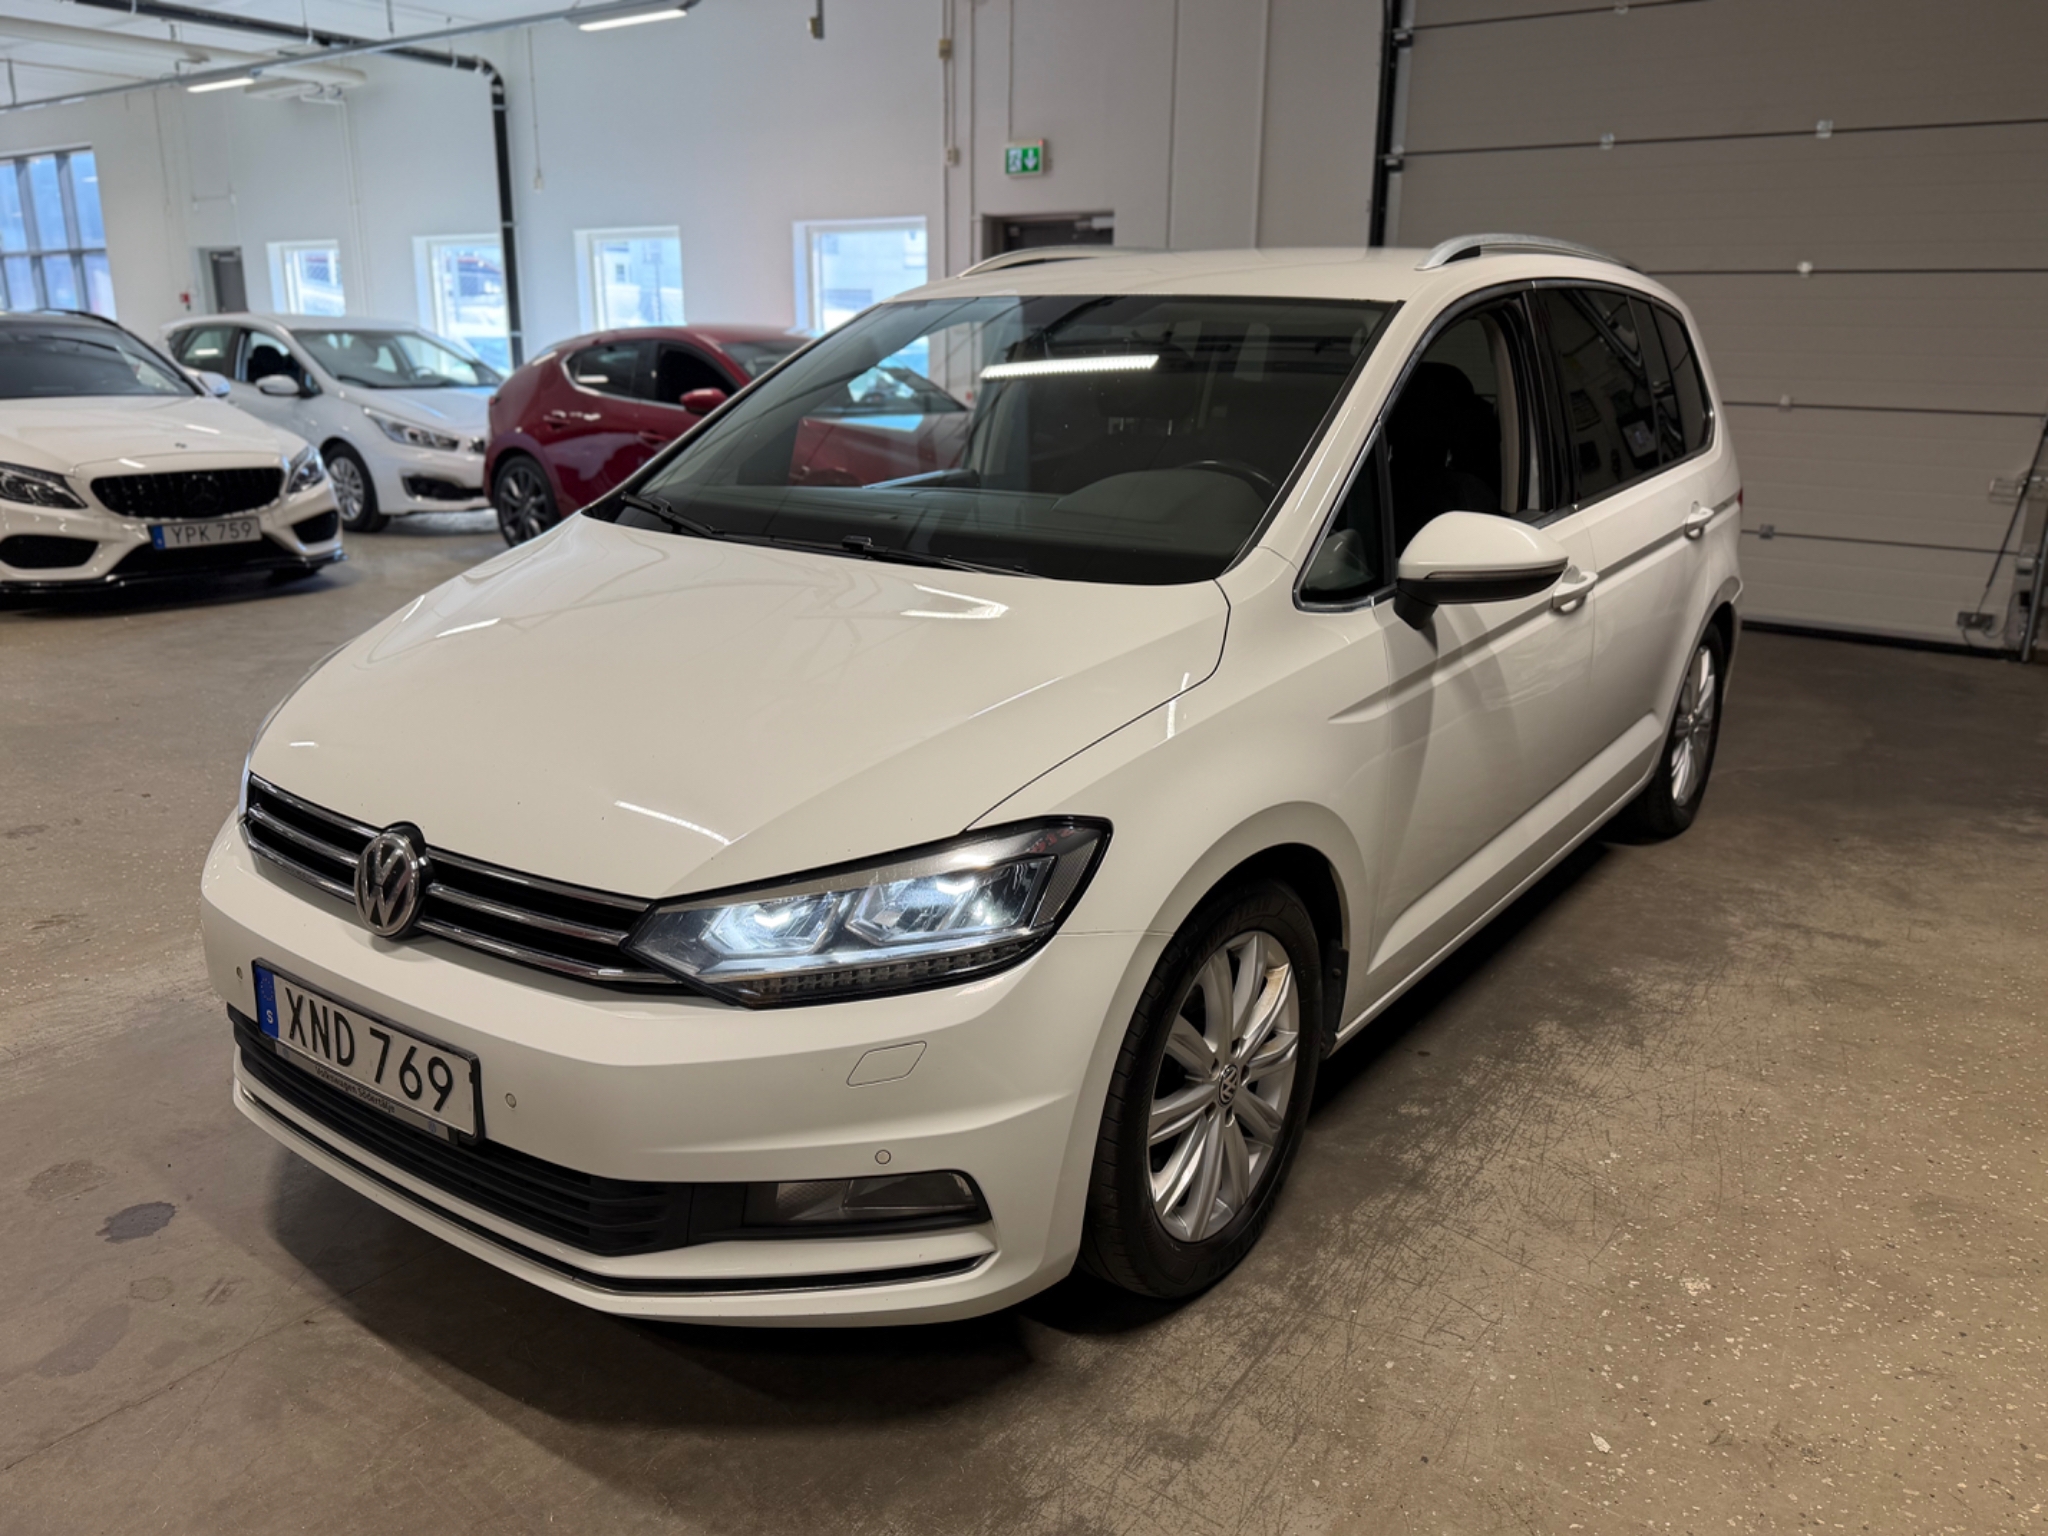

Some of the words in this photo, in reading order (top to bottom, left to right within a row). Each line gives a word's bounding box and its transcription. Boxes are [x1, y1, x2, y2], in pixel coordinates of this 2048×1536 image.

[171, 525, 210, 544] YPK
[216, 521, 252, 540] 759
[266, 1009, 274, 1024] S
[285, 987, 355, 1067] XND
[369, 1026, 453, 1112] 769
